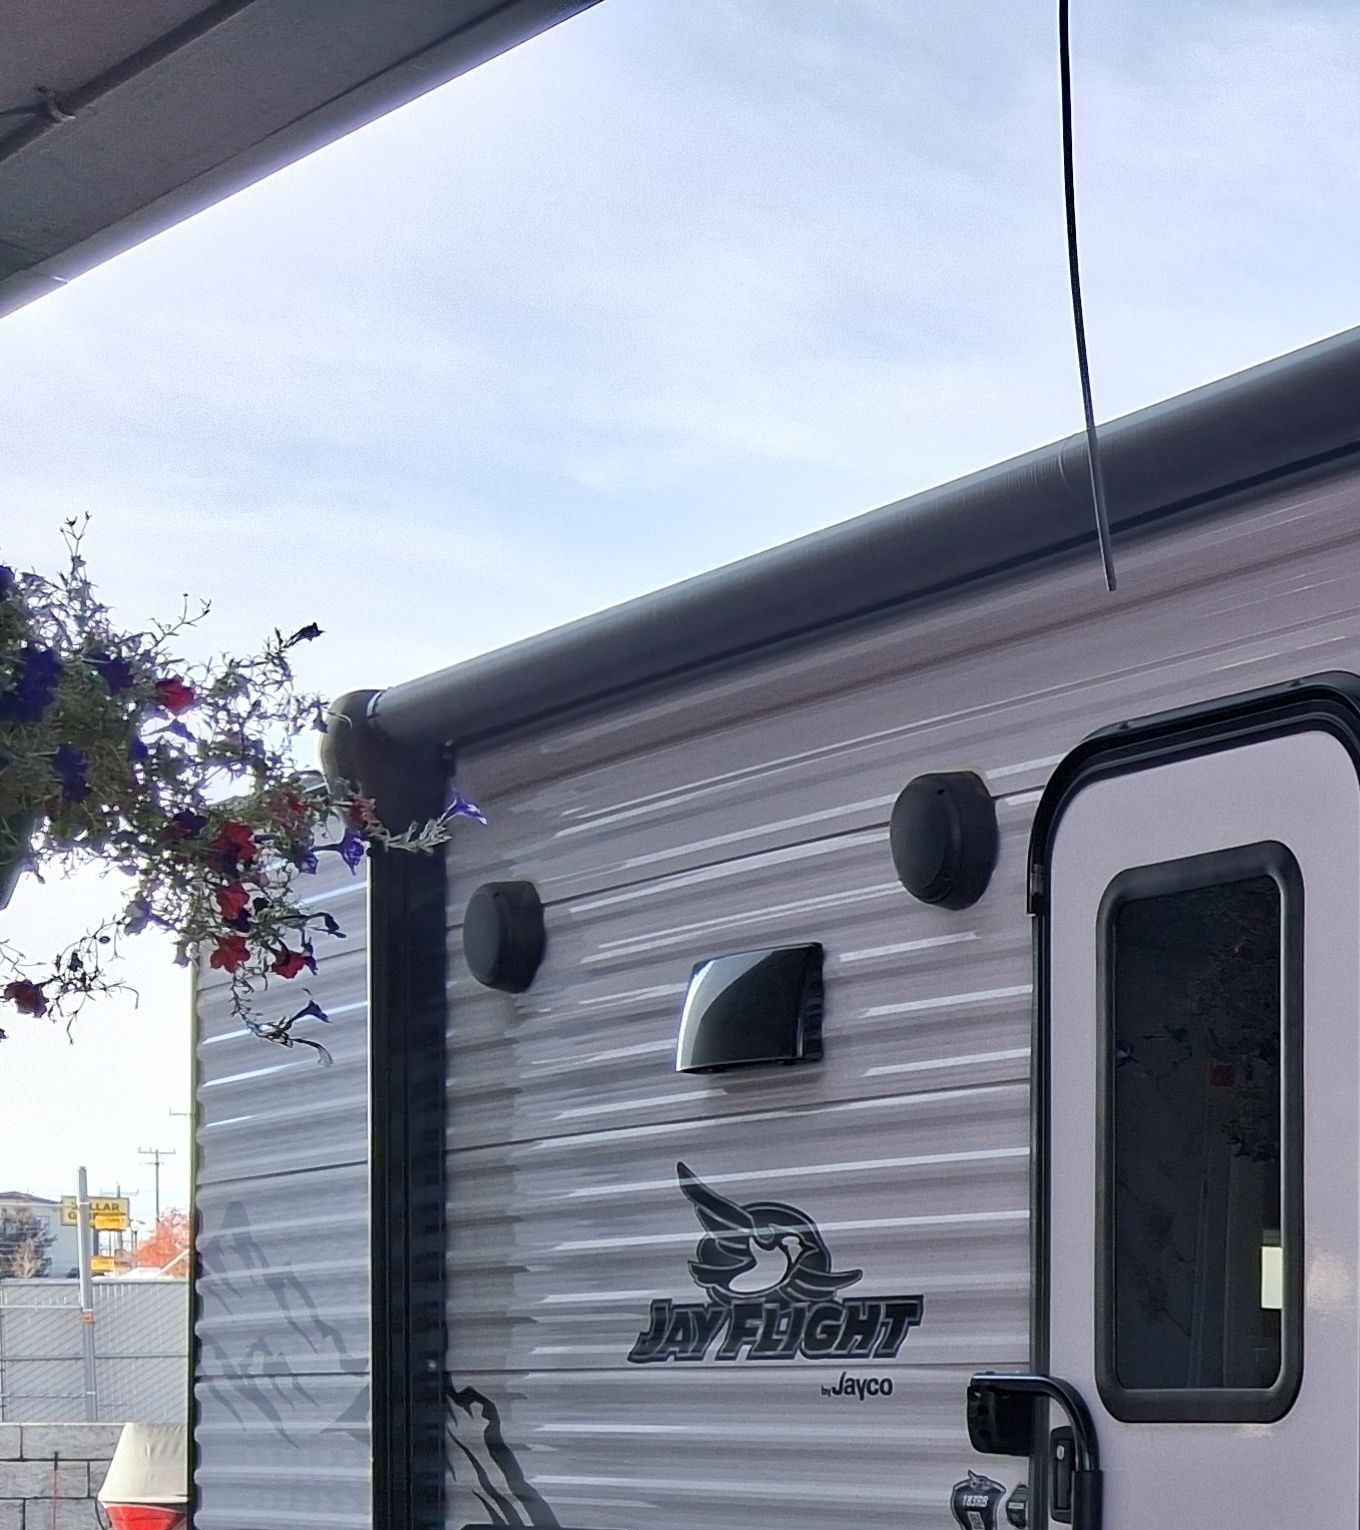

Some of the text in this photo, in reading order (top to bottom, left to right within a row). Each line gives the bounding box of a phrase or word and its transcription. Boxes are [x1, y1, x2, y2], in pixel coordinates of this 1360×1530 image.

[627, 1294, 925, 1363] JAY FLIGHT
[832, 1371, 894, 1401] Jayco
